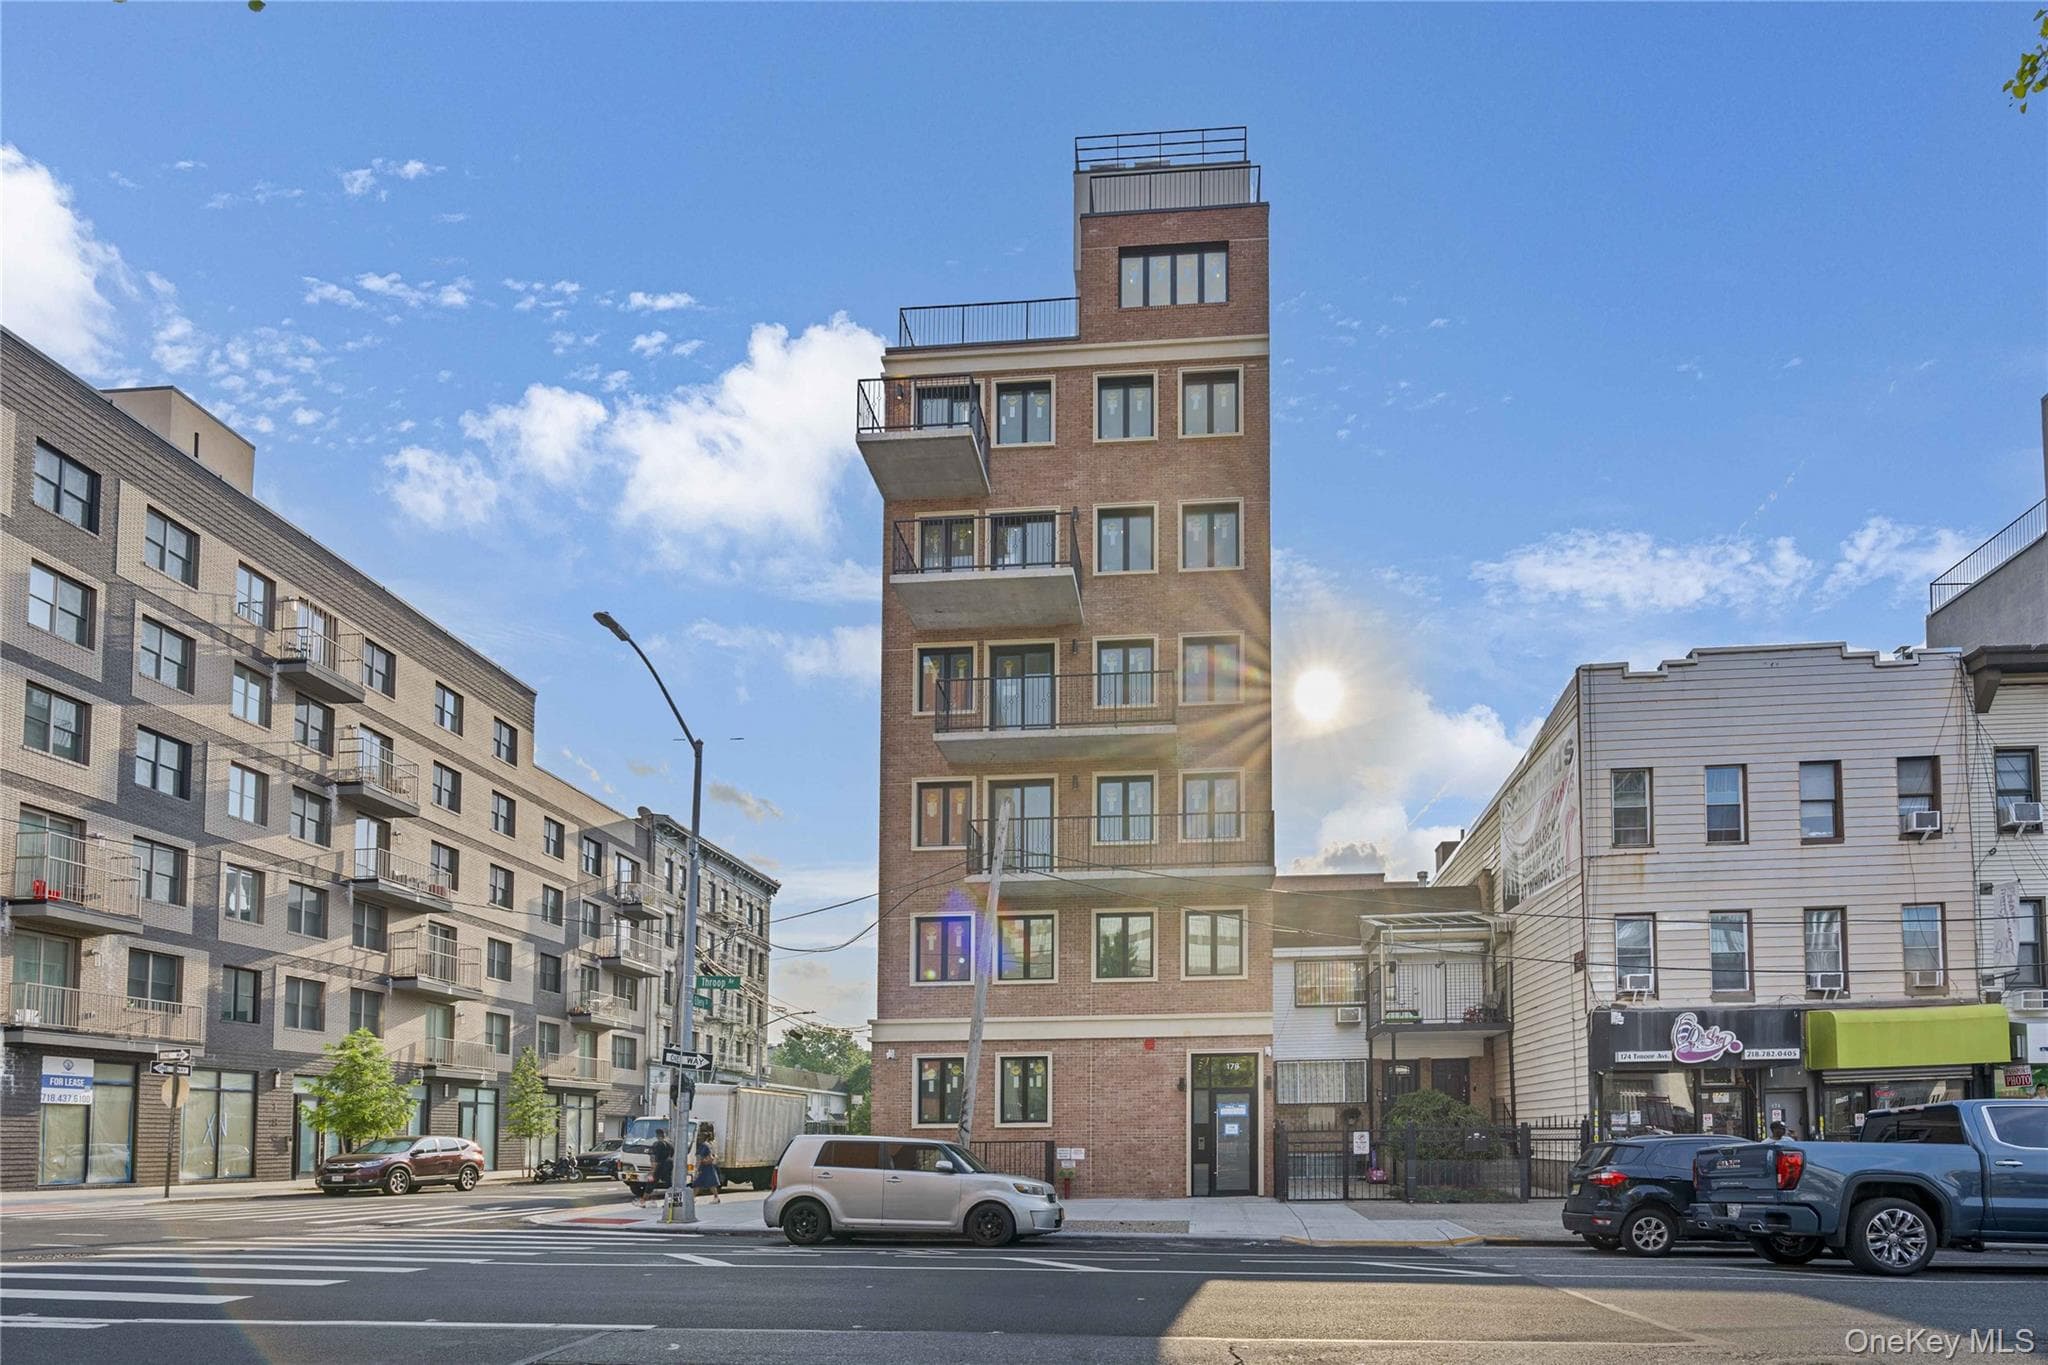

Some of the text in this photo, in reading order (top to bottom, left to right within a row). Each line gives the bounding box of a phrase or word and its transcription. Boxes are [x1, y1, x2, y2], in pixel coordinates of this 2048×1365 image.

[1527, 864, 1555, 896] WHIPPLE
[701, 977, 726, 989] Throop
[687, 1056, 706, 1065] WAY
[50, 1076, 86, 1087] FOR LEASE
[2006, 1075, 2031, 1087] PHOTO
